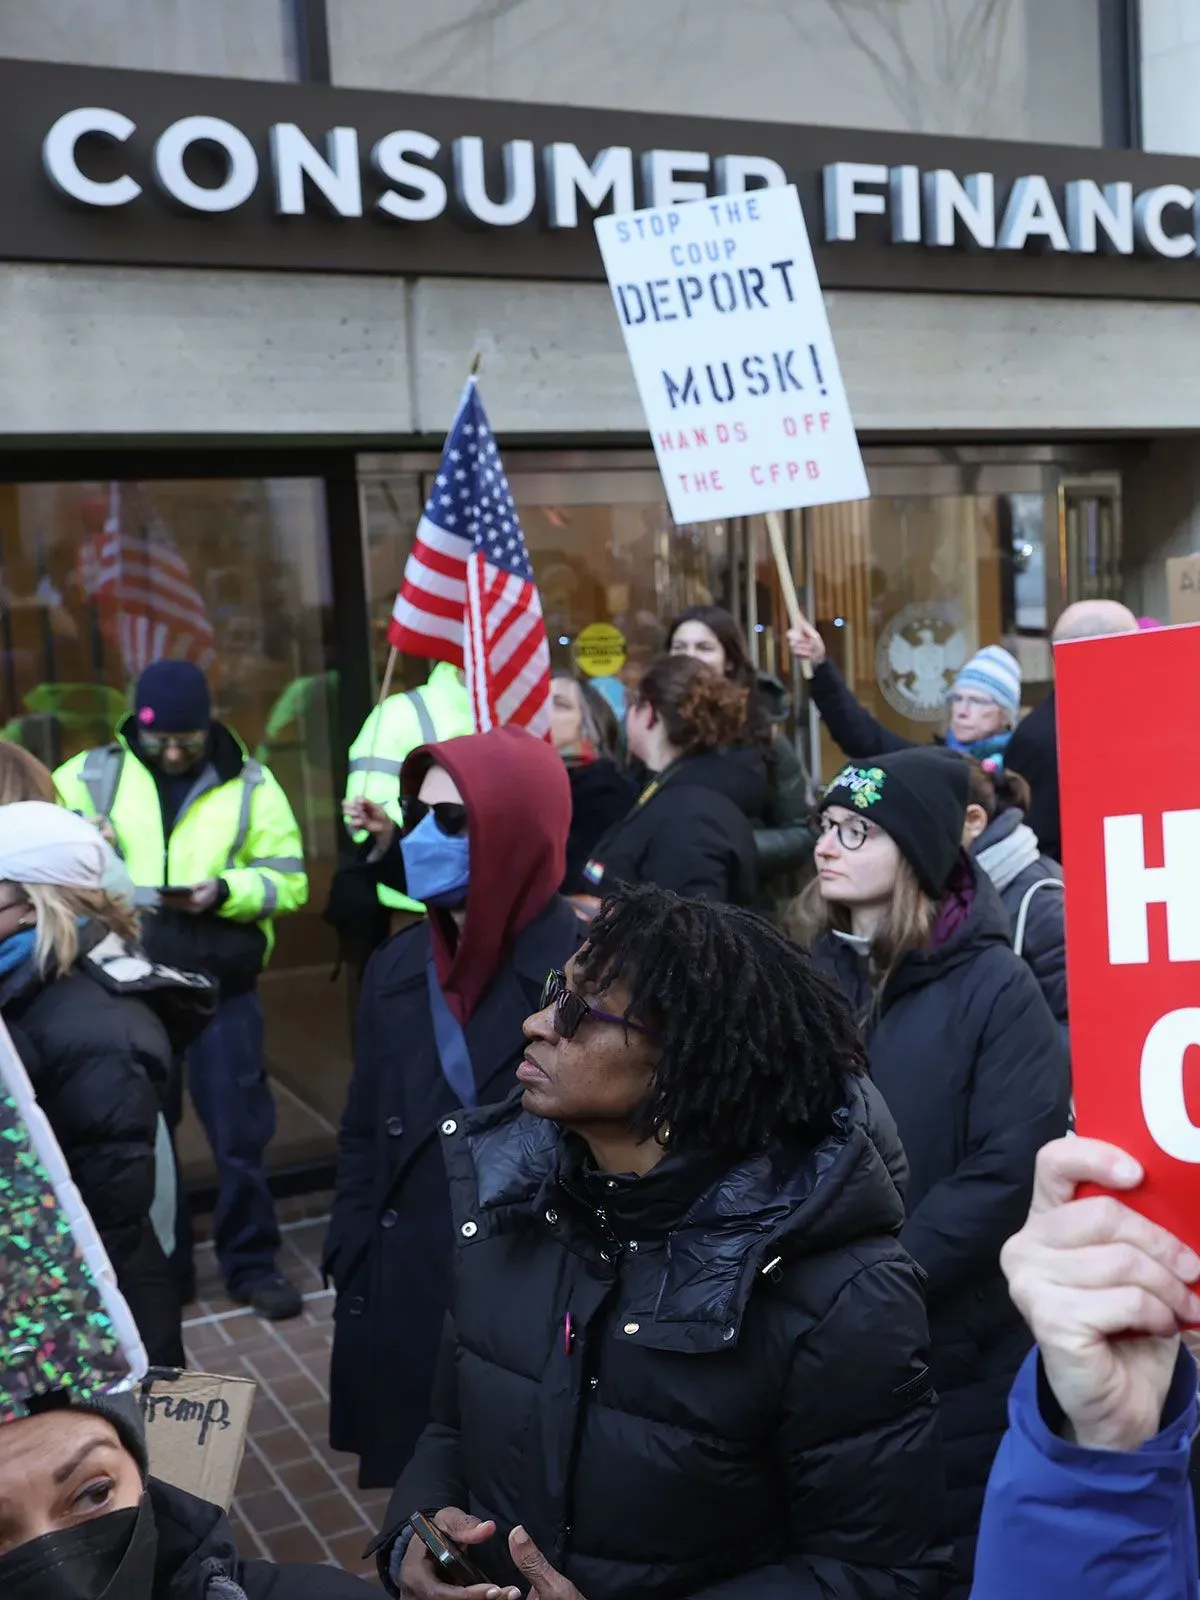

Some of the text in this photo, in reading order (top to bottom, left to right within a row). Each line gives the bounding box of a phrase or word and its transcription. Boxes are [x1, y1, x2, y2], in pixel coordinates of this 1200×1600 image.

[615, 198, 761, 244] STOP THE
[670, 239, 738, 267] COUP
[616, 260, 796, 326] DEPORT
[662, 343, 828, 409] MUSK!
[658, 411, 831, 451] HANDS OFF
[678, 460, 821, 494] THE CFPB
